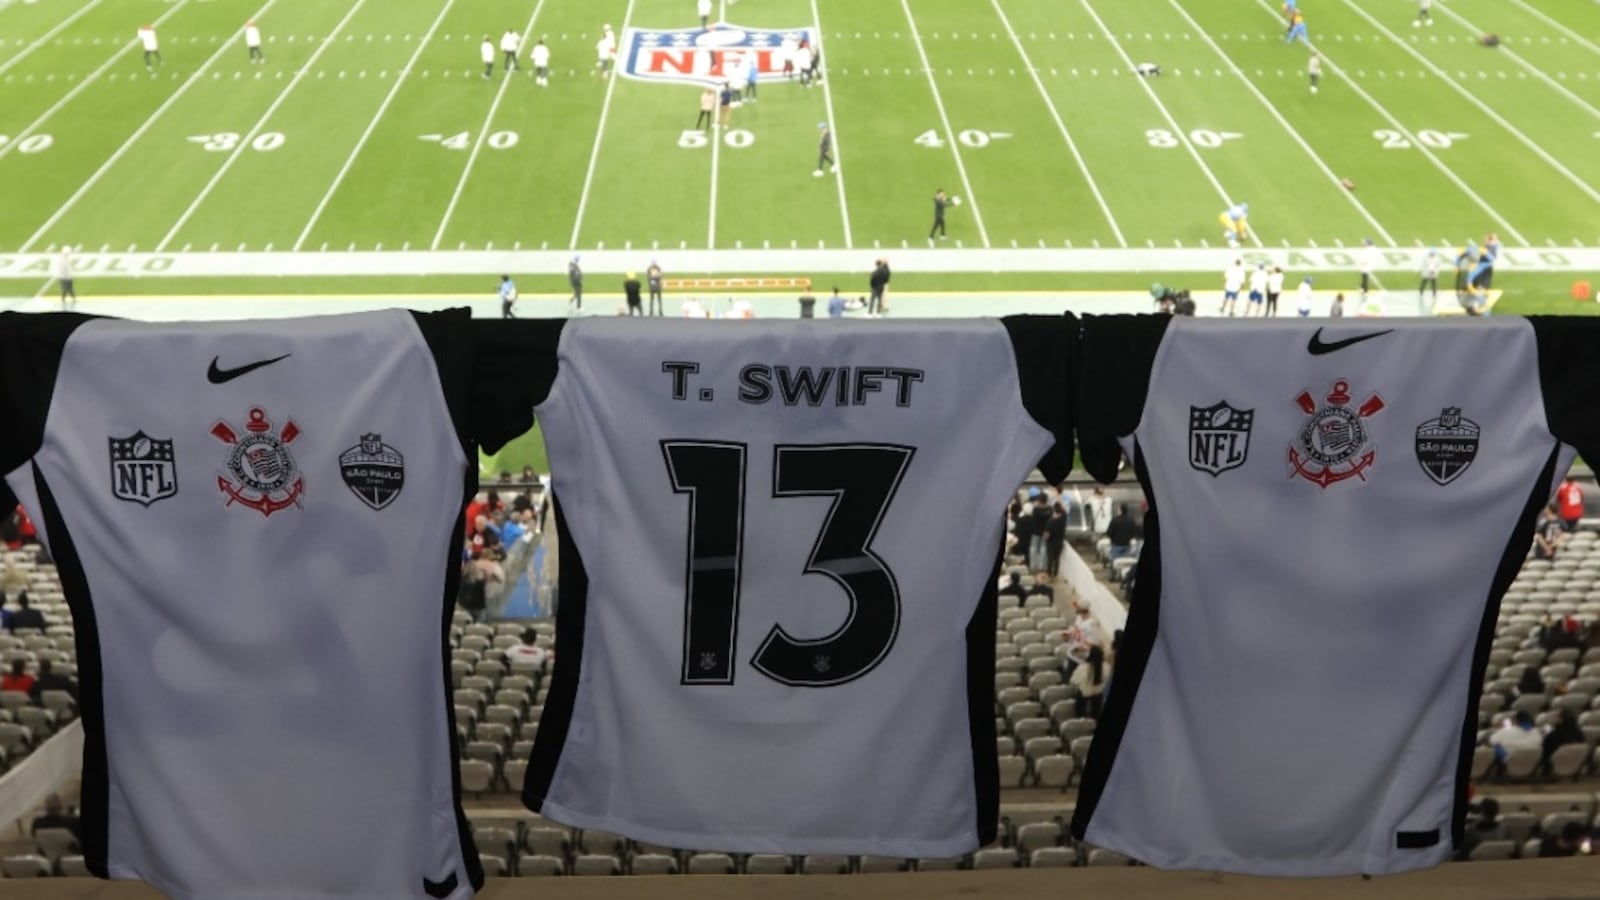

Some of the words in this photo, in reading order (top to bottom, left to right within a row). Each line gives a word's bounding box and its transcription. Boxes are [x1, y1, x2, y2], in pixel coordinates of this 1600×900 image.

[647, 49, 797, 77] NFL
[203, 131, 287, 150] 30
[440, 130, 520, 149] 40
[677, 129, 755, 148] 50
[913, 128, 990, 148] 40
[1144, 128, 1224, 148] 30
[1372, 129, 1452, 148] 20
[662, 361, 714, 400] T.
[738, 364, 925, 408] SWIFT
[1194, 432, 1242, 468] NFL
[1441, 443, 1475, 453] PAULO
[117, 463, 173, 498] NFL
[369, 469, 402, 480] PAULO
[659, 439, 918, 688] 13
